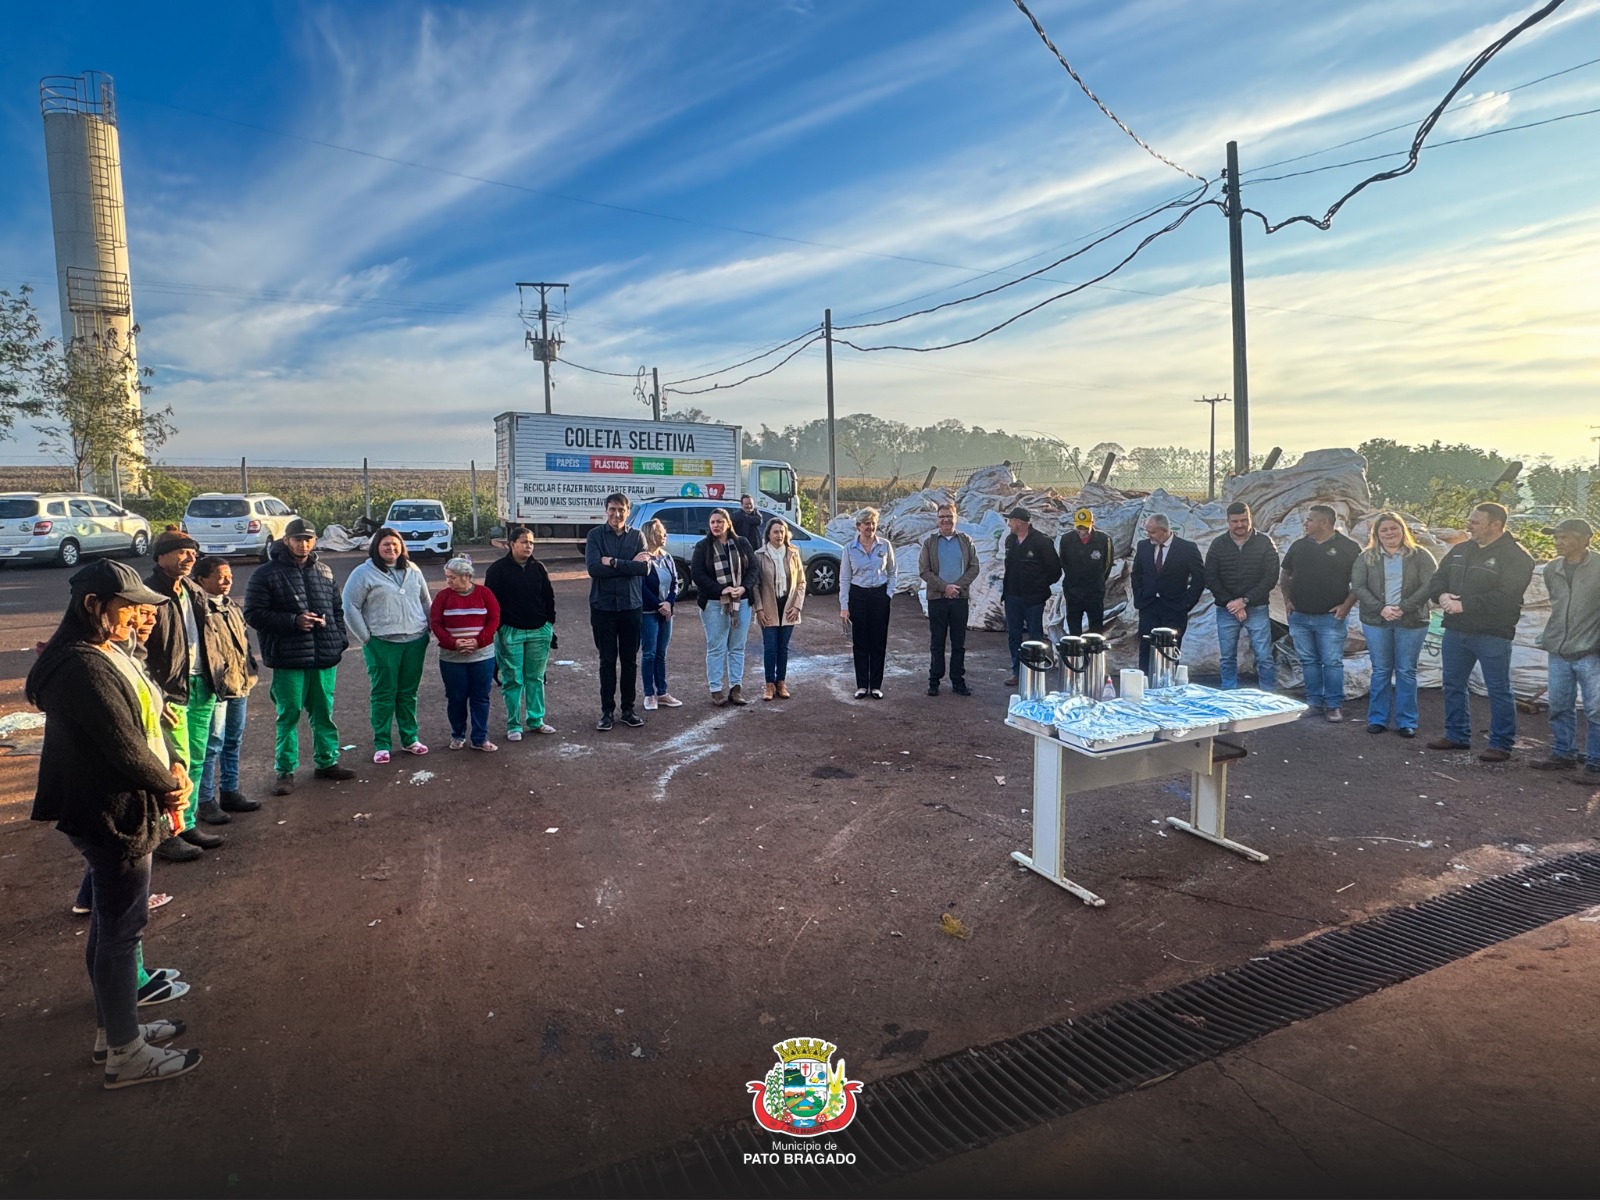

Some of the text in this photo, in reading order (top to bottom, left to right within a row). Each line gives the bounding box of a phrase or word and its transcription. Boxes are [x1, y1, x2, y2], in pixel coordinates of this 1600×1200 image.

[565, 427, 695, 452] COLETA SELETIVA
[594, 459, 629, 470] PLÁSTICOS
[641, 461, 665, 471] VIDROS
[523, 482, 556, 493] RECICLAR
[562, 484, 583, 493] FAZER
[584, 484, 606, 494] NOSSA
[606, 485, 626, 494] PARTE
[627, 486, 644, 494] PARA
[645, 486, 655, 495] UM
[523, 496, 549, 506] MUNDO
[550, 497, 567, 507] MAIS
